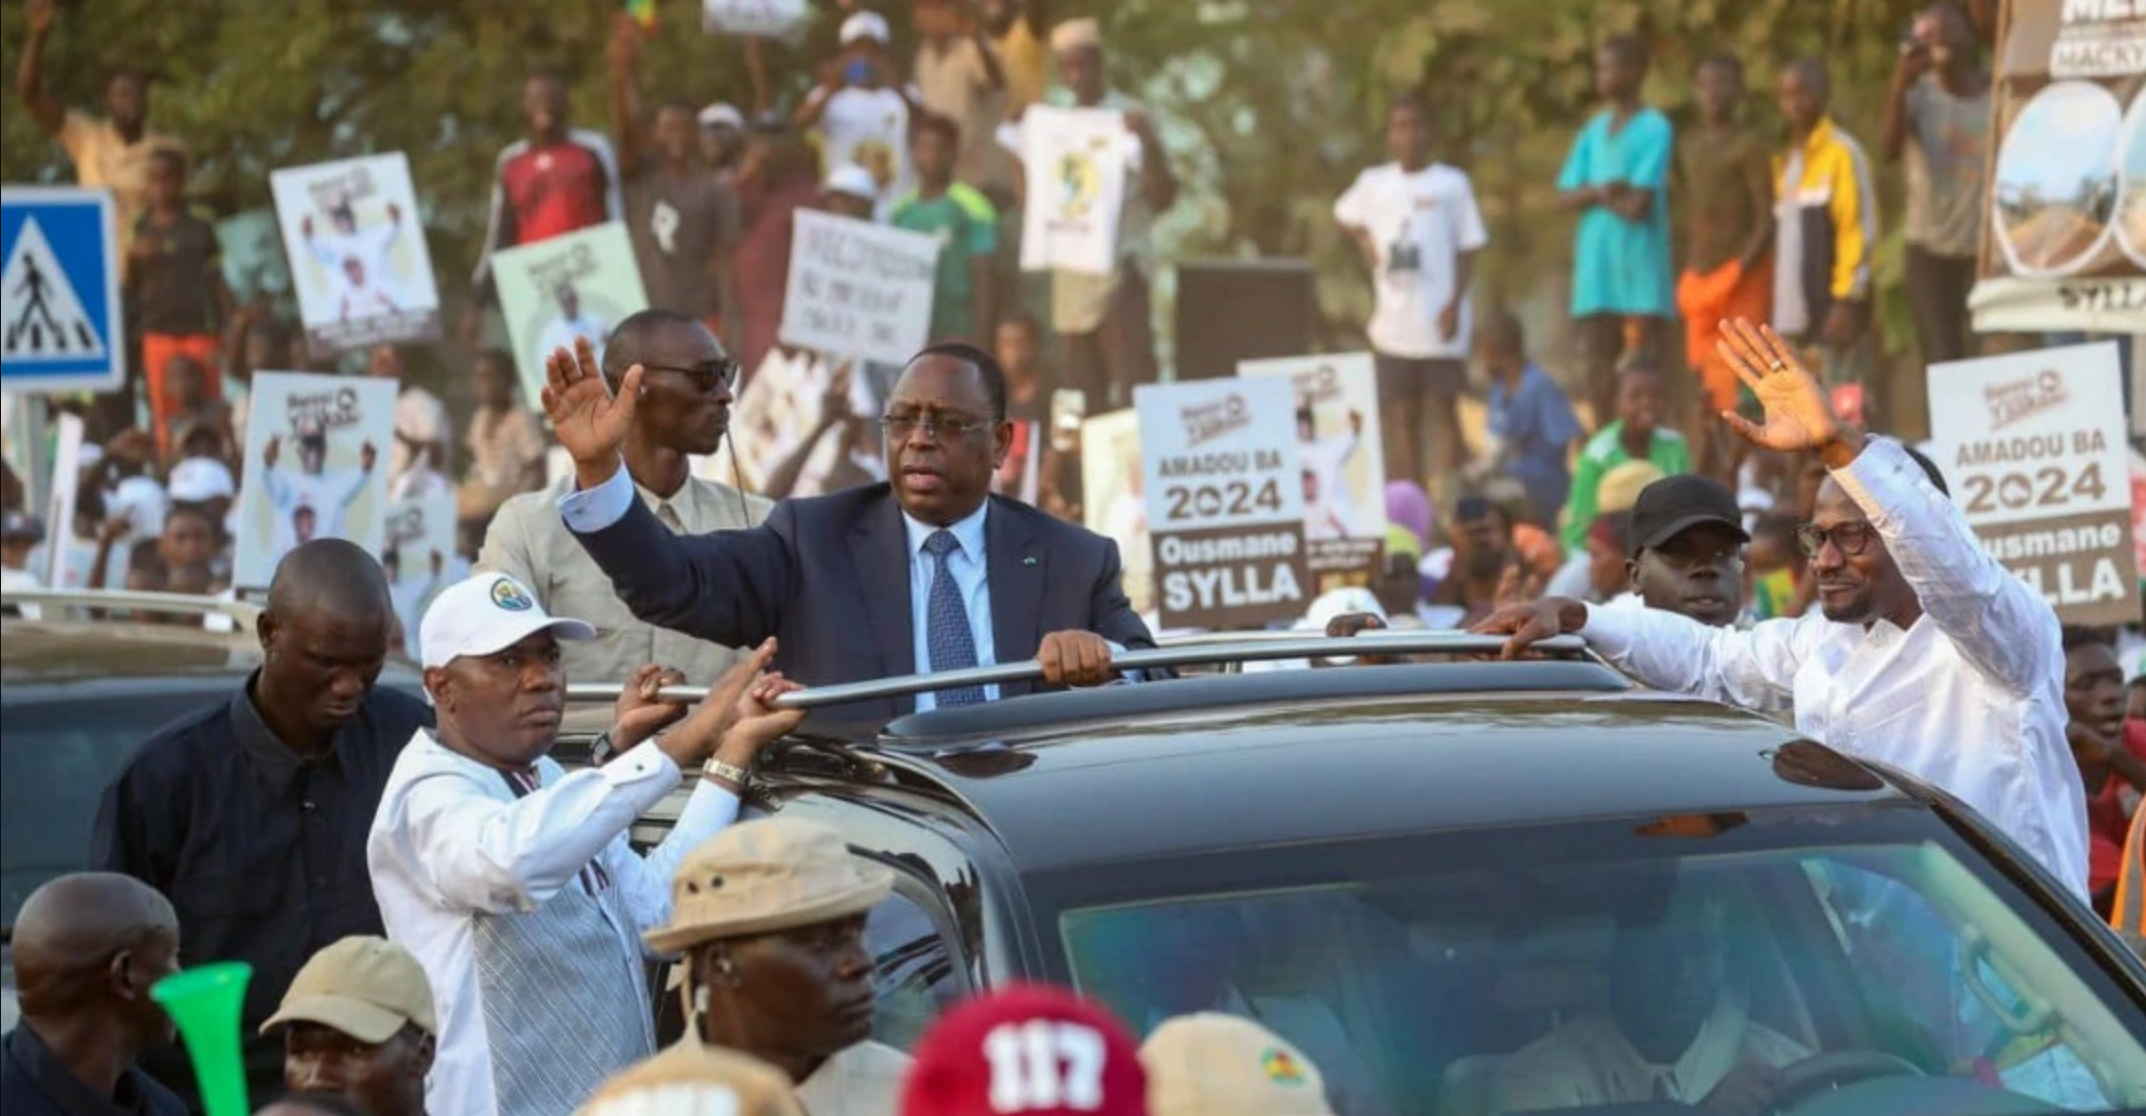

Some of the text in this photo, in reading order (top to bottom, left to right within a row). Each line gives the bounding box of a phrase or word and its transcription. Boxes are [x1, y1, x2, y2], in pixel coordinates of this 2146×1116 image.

[2057, 280, 2146, 311] SYLL
[1158, 448, 1283, 478] AMADOU BA
[1957, 428, 2107, 466] AMADOU BA
[1164, 476, 1283, 520] 2024
[1962, 462, 2107, 515] 2024
[1159, 533, 1297, 566] Ousmane
[1984, 523, 2121, 560] usmane
[1163, 562, 1302, 612] SYLLA
[2013, 557, 2126, 604] LLA
[982, 1017, 1107, 1113] 117
